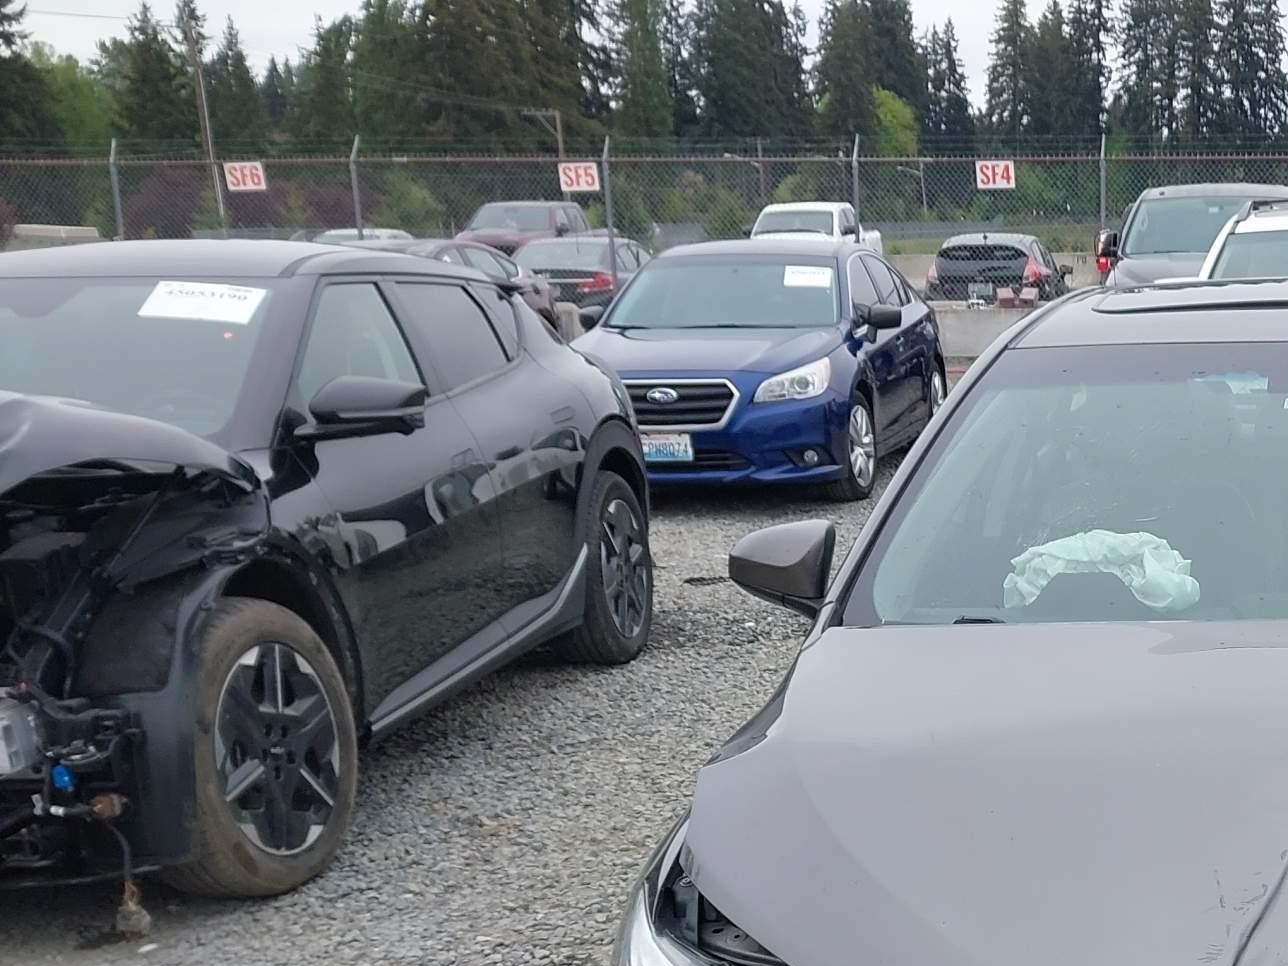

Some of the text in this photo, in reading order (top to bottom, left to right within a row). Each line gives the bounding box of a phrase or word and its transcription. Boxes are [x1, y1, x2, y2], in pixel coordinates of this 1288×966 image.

[228, 165, 262, 187] SF6
[562, 165, 595, 187] SF5
[980, 164, 1011, 185] SF4
